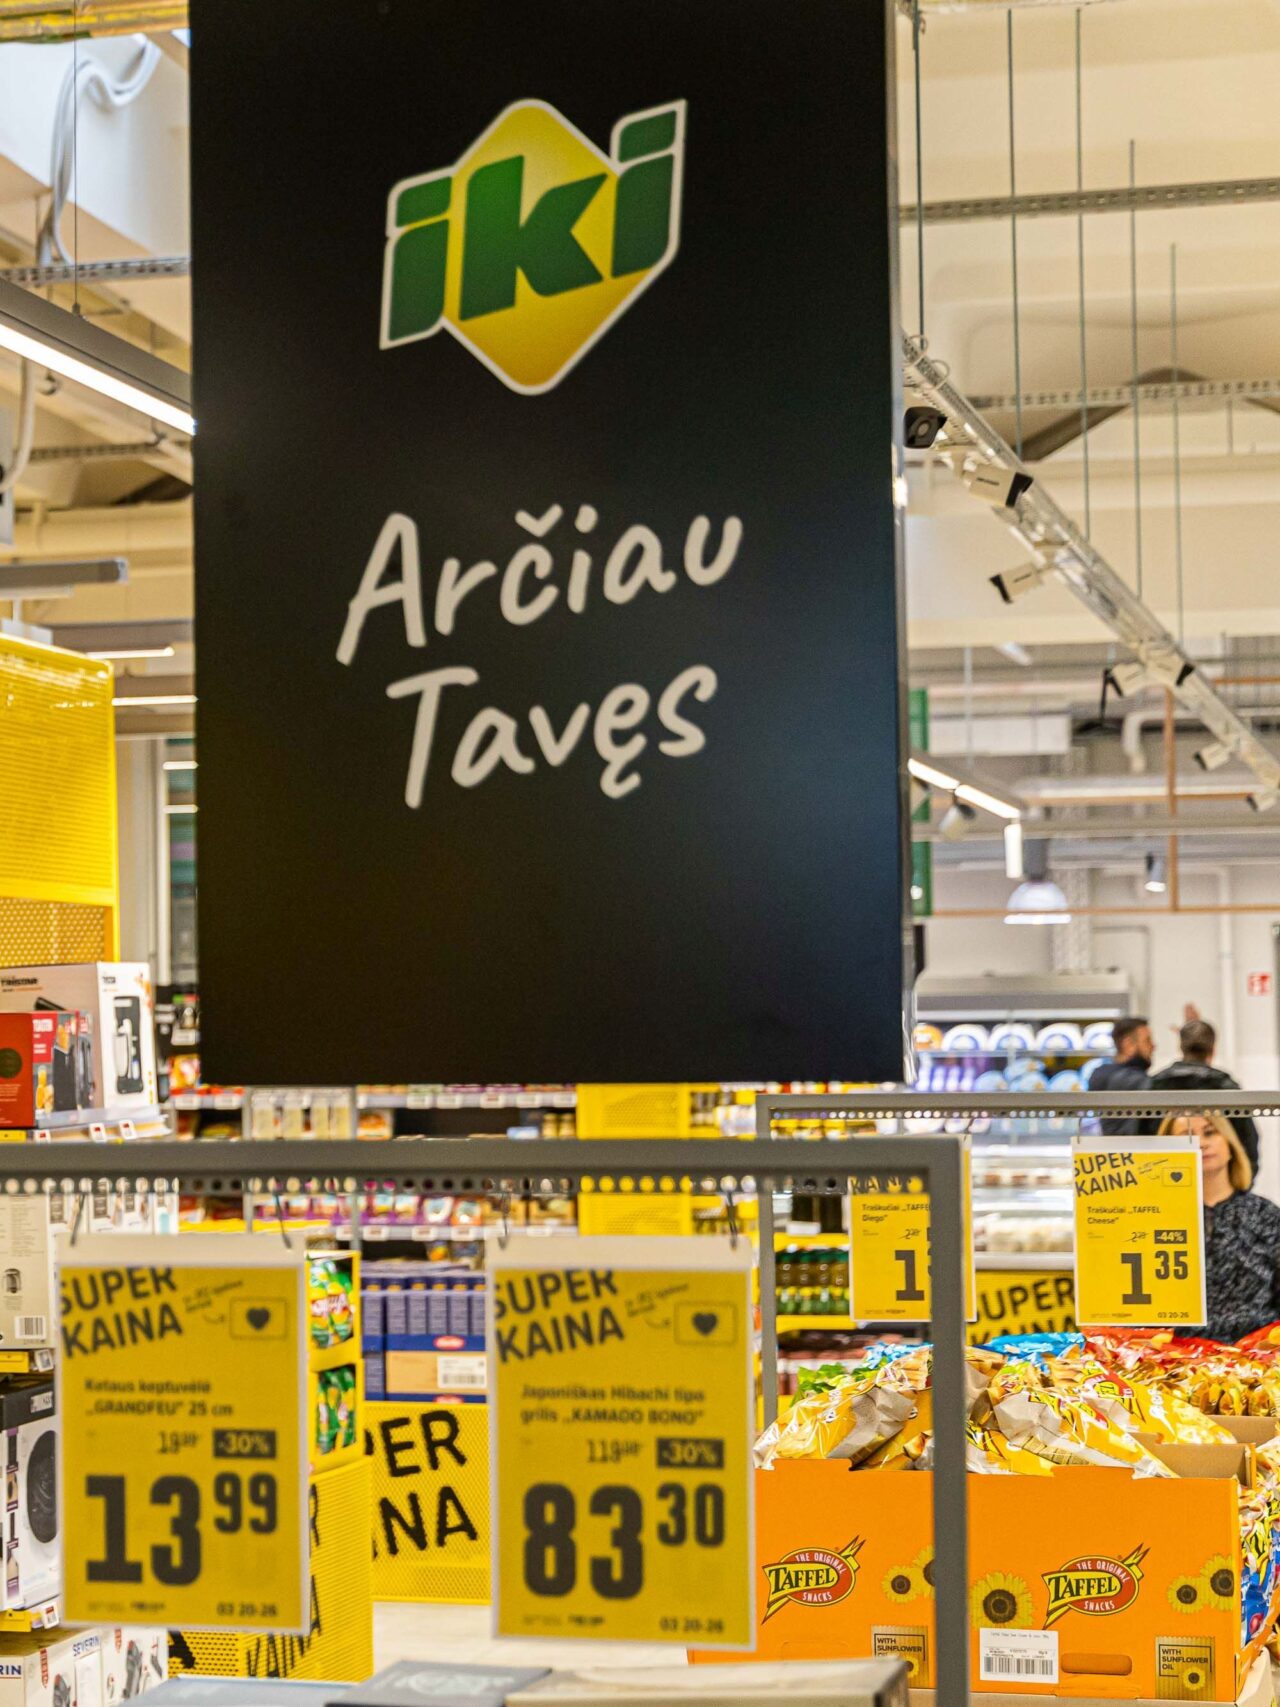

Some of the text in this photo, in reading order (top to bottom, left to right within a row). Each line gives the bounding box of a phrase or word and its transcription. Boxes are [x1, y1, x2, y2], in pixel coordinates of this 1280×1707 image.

[389, 108, 677, 342] iki
[336, 504, 742, 665] Arčiau
[386, 666, 717, 808] Tavęs
[1075, 1169, 1138, 1197] KAINA
[902, 1203, 930, 1212] „TAFFE
[1157, 1231, 1184, 1242] -44%
[895, 1250, 925, 1301] 1
[1121, 1250, 1189, 1305] 1 35
[968, 1277, 1075, 1325] UPER
[62, 1303, 183, 1359] KAINA
[496, 1306, 625, 1364] KAINA
[188, 1401, 207, 1416] 25
[211, 1404, 234, 1416] cm
[219, 1433, 270, 1454] -30%
[662, 1440, 717, 1463] -30%
[85, 1475, 202, 1587] 13
[214, 1471, 277, 1535] 99
[523, 1483, 644, 1601] 83
[657, 1482, 725, 1547] 30
[795, 1552, 847, 1574] THE ORIGINAL
[1077, 1560, 1131, 1584] THE ORIGINAL
[769, 1567, 835, 1595] TAFFEL
[1048, 1575, 1118, 1603] TAFFEL
[802, 1591, 833, 1602] SNACKS
[1084, 1600, 1116, 1611] SNACKS
[72, 1635, 100, 1657] SEVERIN
[1162, 1656, 1209, 1664] SUNFLOWER
